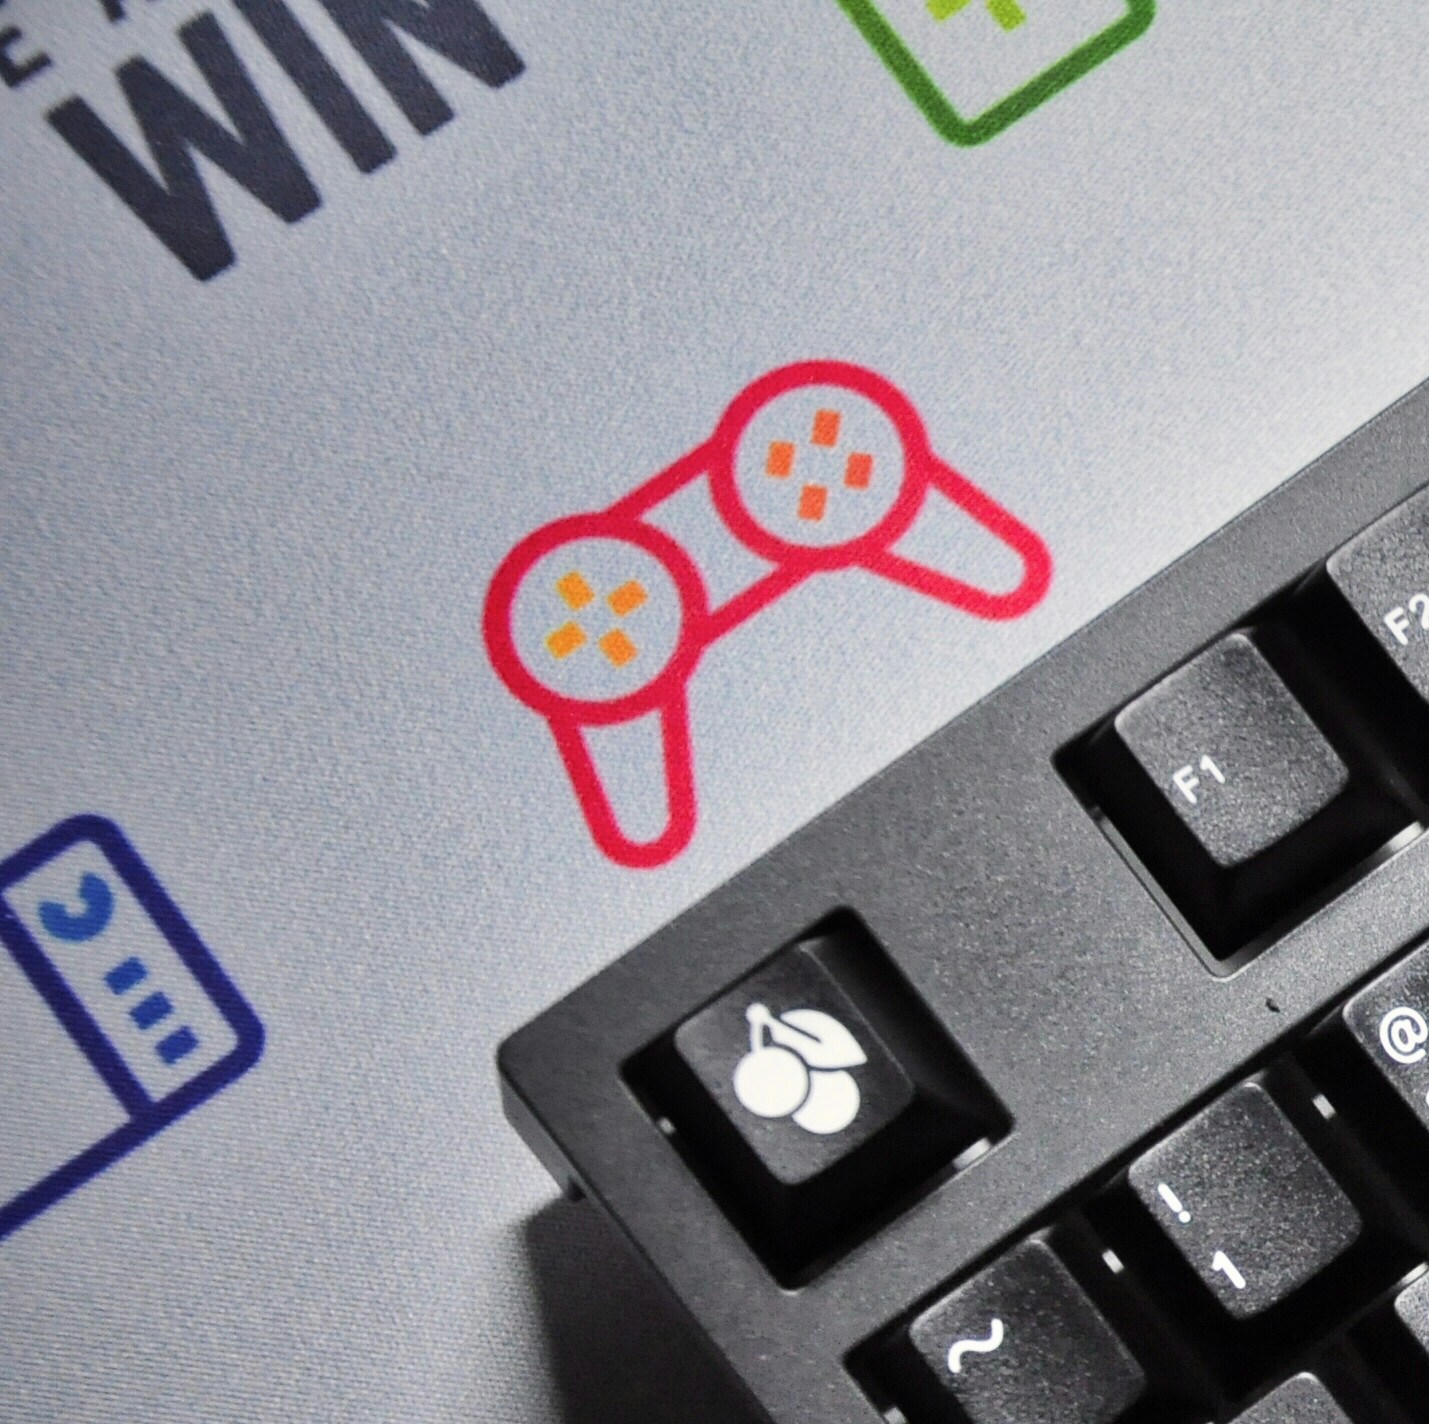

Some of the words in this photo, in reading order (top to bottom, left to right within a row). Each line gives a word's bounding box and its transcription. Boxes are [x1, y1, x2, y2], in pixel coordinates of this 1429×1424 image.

[45, 0, 527, 283] WIN
[1171, 754, 1226, 805] F1
[1378, 1005, 1429, 1065] @
[1156, 1182, 1192, 1224] !
[1210, 1249, 1247, 1290] 1
